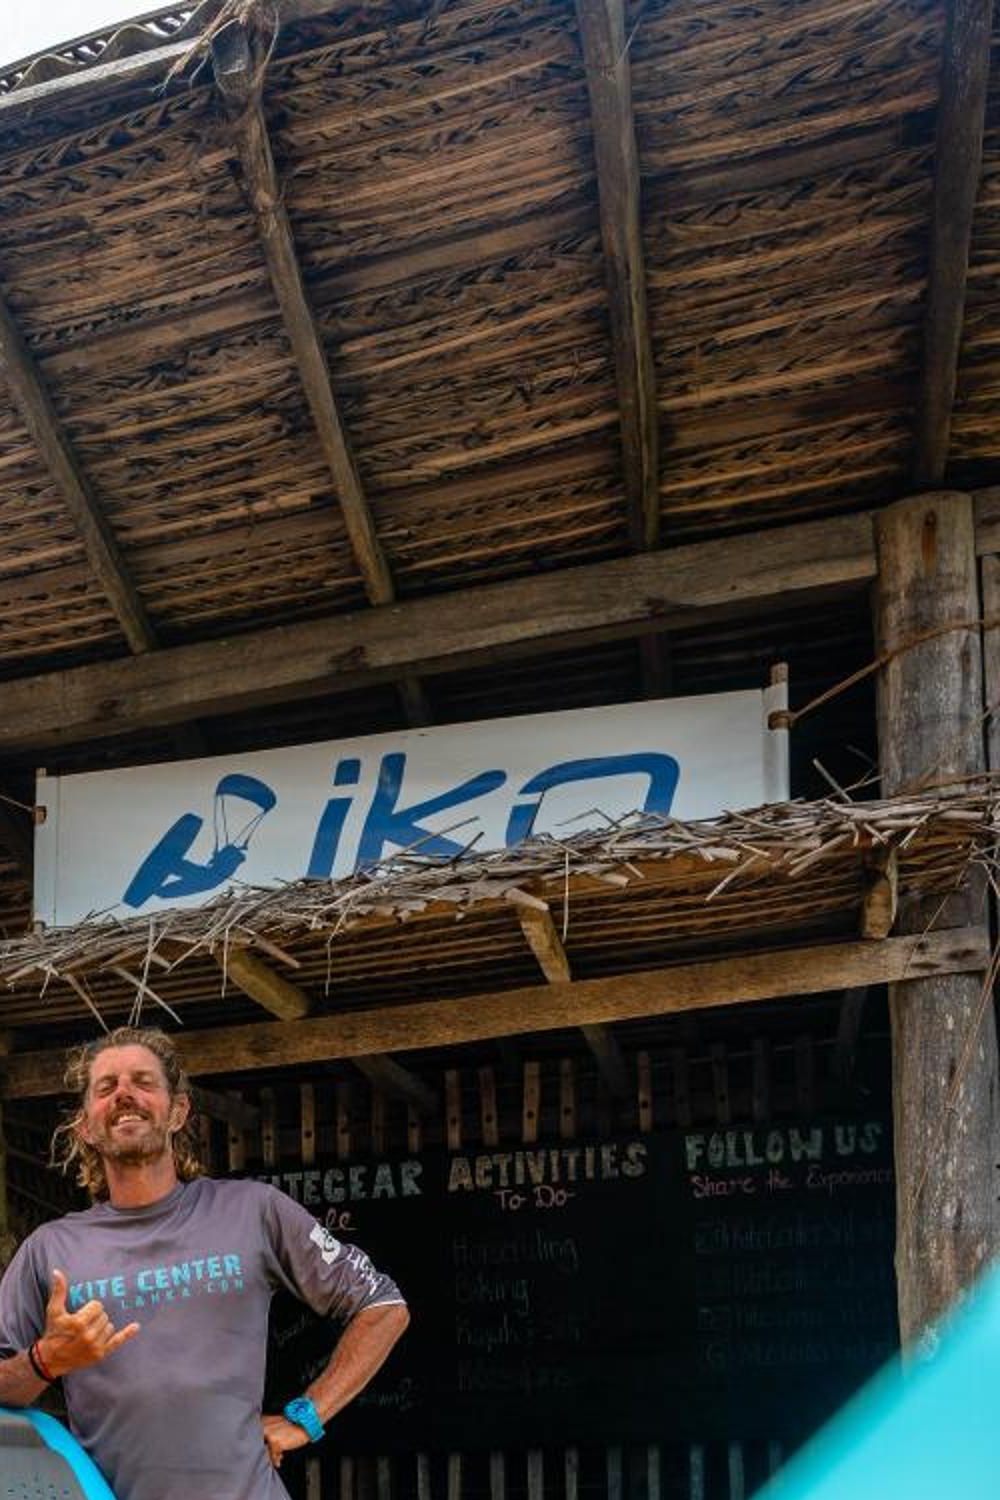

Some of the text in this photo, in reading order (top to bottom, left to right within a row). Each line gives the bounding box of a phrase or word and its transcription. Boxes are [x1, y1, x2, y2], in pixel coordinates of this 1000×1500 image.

[447, 1141, 648, 1192] ACTIVITIES
[684, 1121, 884, 1172] FOLLOW US
[257, 1159, 424, 1205] TEGEAR
[691, 1174, 757, 1199] Share
[70, 1254, 242, 1308] KITE CENTER
